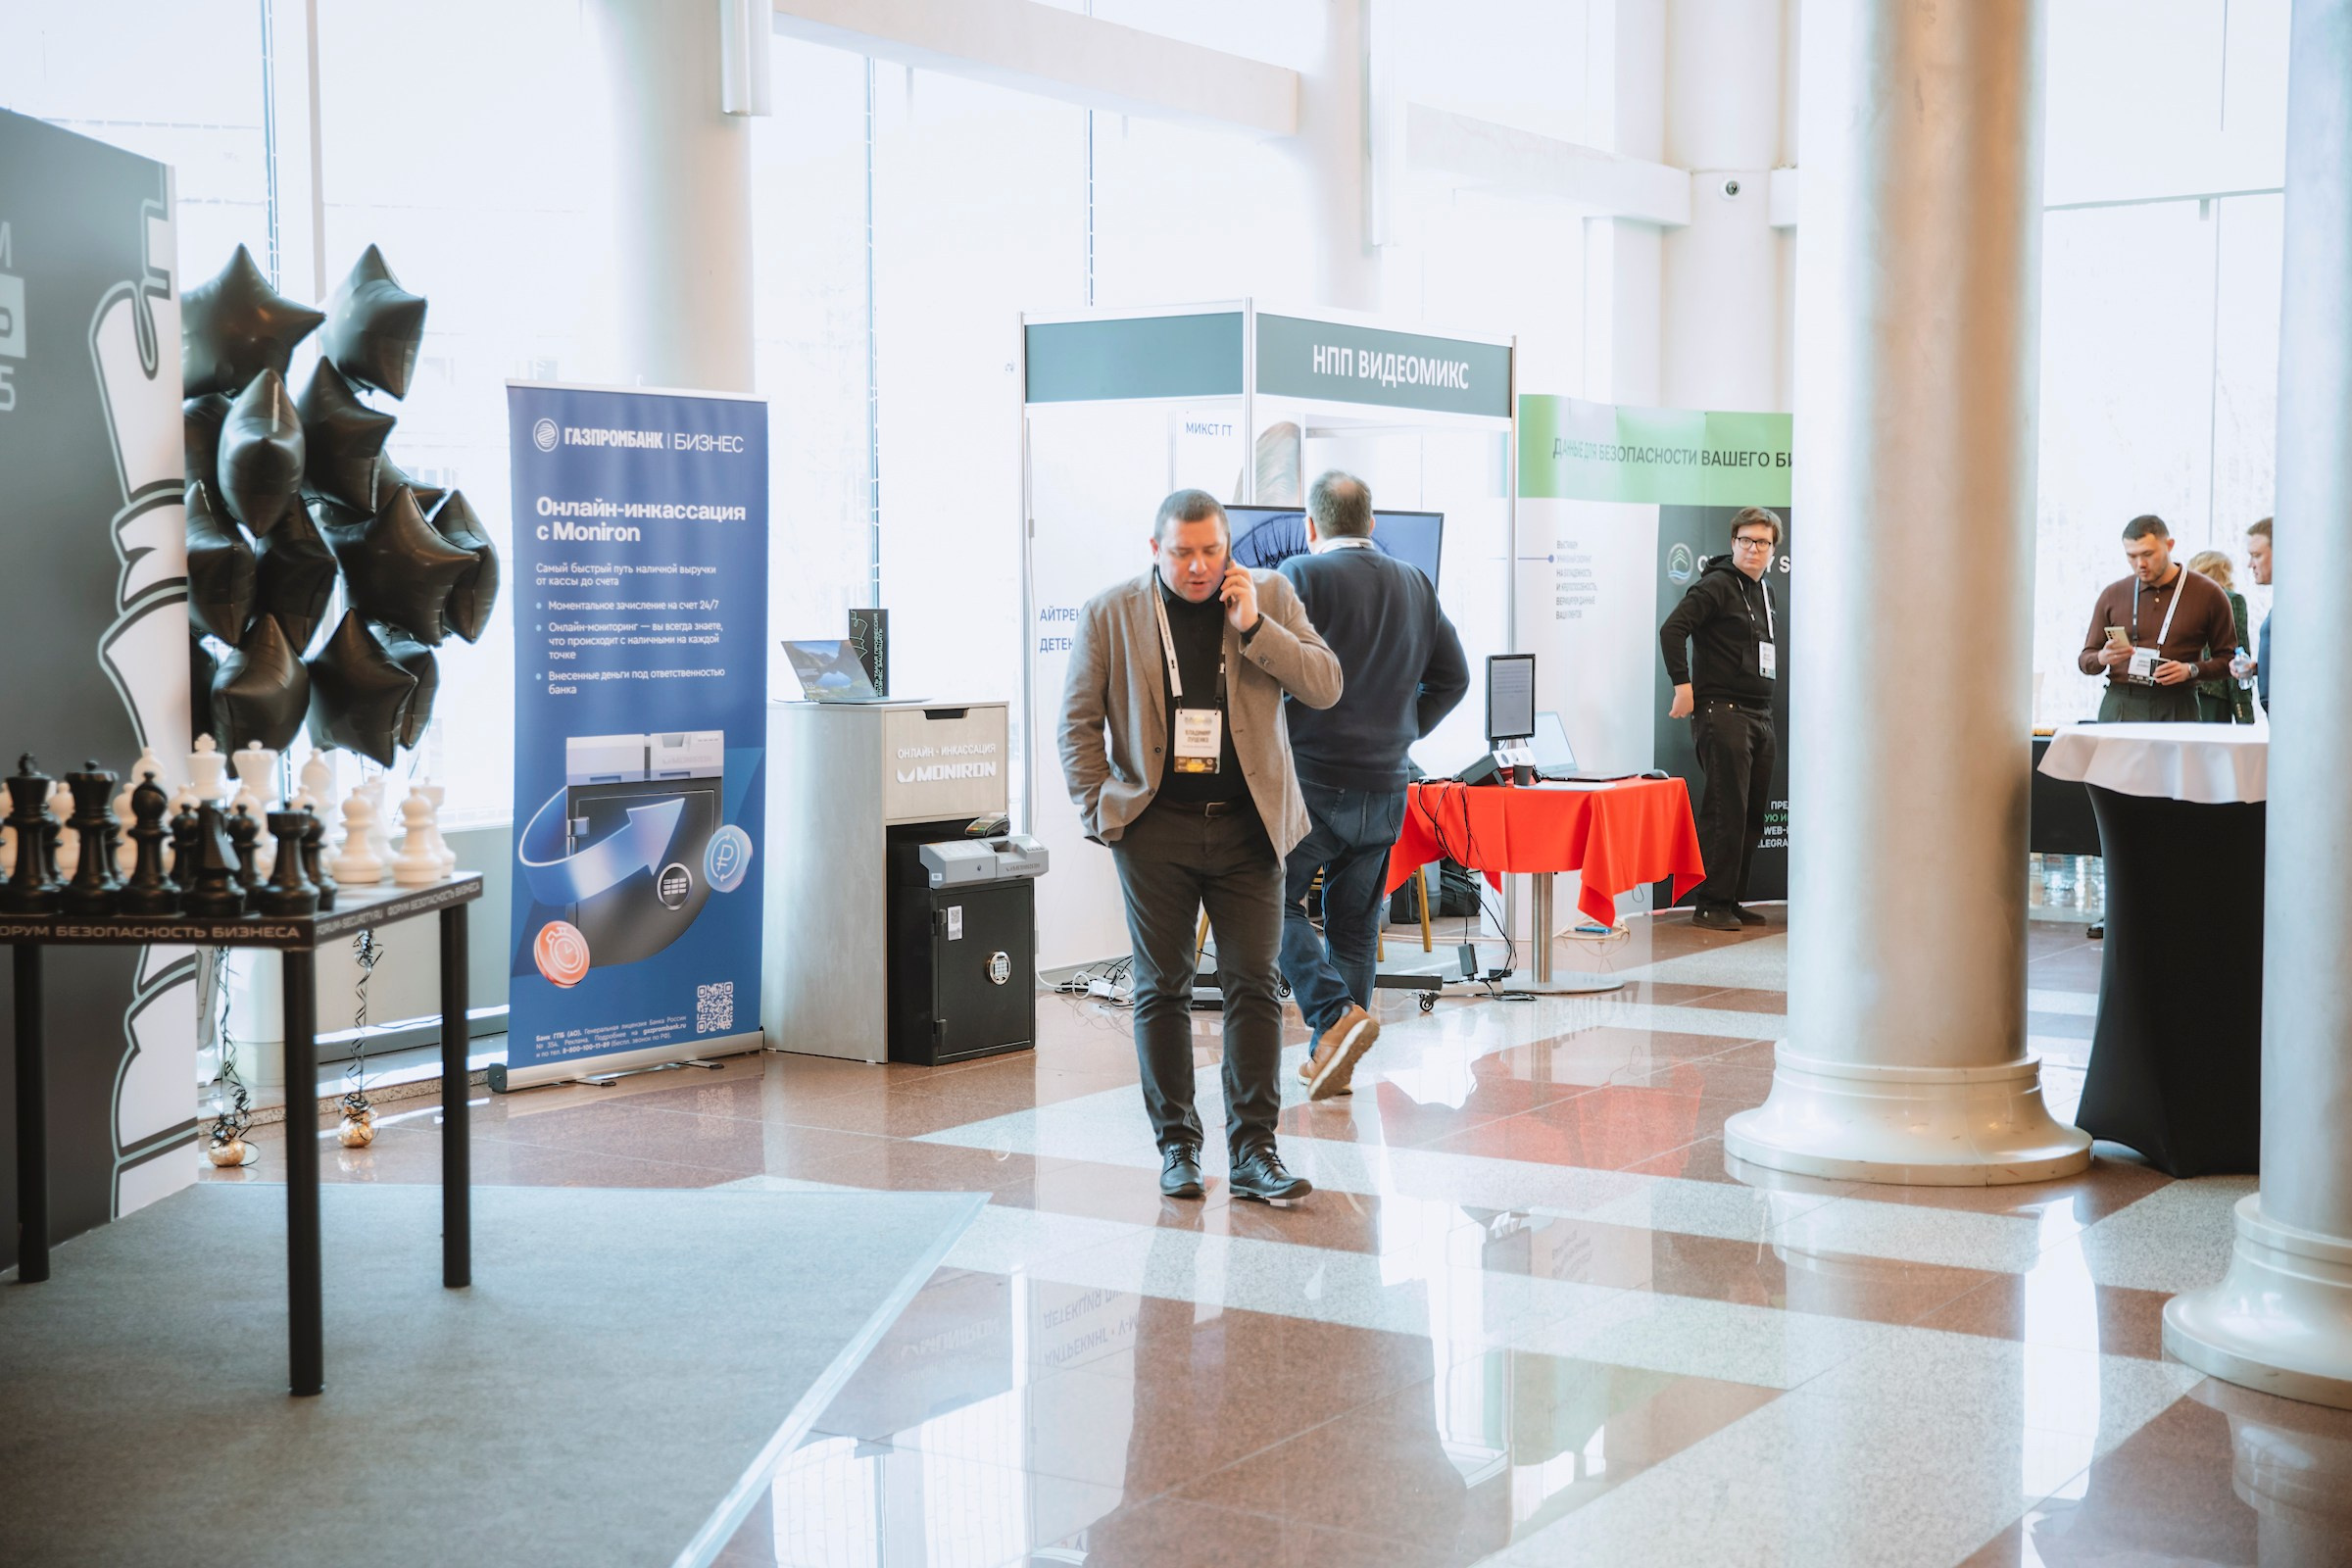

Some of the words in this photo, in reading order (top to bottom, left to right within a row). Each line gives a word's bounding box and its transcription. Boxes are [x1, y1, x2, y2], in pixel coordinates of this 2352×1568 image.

[1313, 345, 1352, 377] НПП
[1358, 350, 1469, 389] ВИДЕОМИКС
[1186, 422, 1219, 435] МИКСТ
[1221, 424, 1233, 437] ГТ
[564, 427, 663, 450] ГАЗПРОМБАНК
[674, 433, 744, 453] БИЗНЕС
[1599, 444, 1697, 466] БЕЗОПАСНОСТИ
[1701, 451, 1770, 467] ВАШЕГО
[536, 496, 746, 522] Онлайн-инкассация
[536, 526, 549, 541] с
[553, 521, 641, 543] Moniron
[536, 563, 568, 573] Самый
[571, 563, 612, 576] быстрый
[613, 564, 633, 576] путь
[636, 563, 677, 574] наличной
[679, 564, 716, 576] выручки
[536, 576, 547, 586] от
[549, 577, 578, 586] кассы
[580, 576, 594, 588] до
[595, 576, 619, 586] счета
[549, 600, 614, 611] Моментальное
[616, 601, 666, 610] зачисление
[668, 601, 677, 610] на
[679, 601, 698, 610] счет
[700, 599, 719, 612] 24/7
[549, 621, 639, 633] Онлайн-мониторинг
[665, 622, 692, 633] всегда
[694, 622, 723, 633] знаете,
[549, 637, 565, 646] что
[567, 636, 618, 648] происходит
[628, 635, 675, 644] наличными
[676, 635, 686, 644] на
[688, 633, 719, 645] каждой
[549, 651, 576, 660] точке
[549, 670, 600, 681] Внесенные
[602, 670, 631, 681] деньги
[632, 670, 649, 680] под
[651, 667, 725, 678] ответственностью
[549, 685, 576, 695] банка
[898, 746, 933, 759] ОНЛАЙН
[941, 743, 996, 756] ИНКАССАЦИЯ
[916, 761, 997, 781] MONIRON
[1758, 838, 1788, 848] LEGRA
[56, 926, 206, 939] БЕЗОПАСНОСТЬ
[212, 926, 300, 939] БИЗНЕСА
[643, 1022, 686, 1035] gazprombank.ru
[563, 1042, 611, 1054] 8-800-100-11-89
